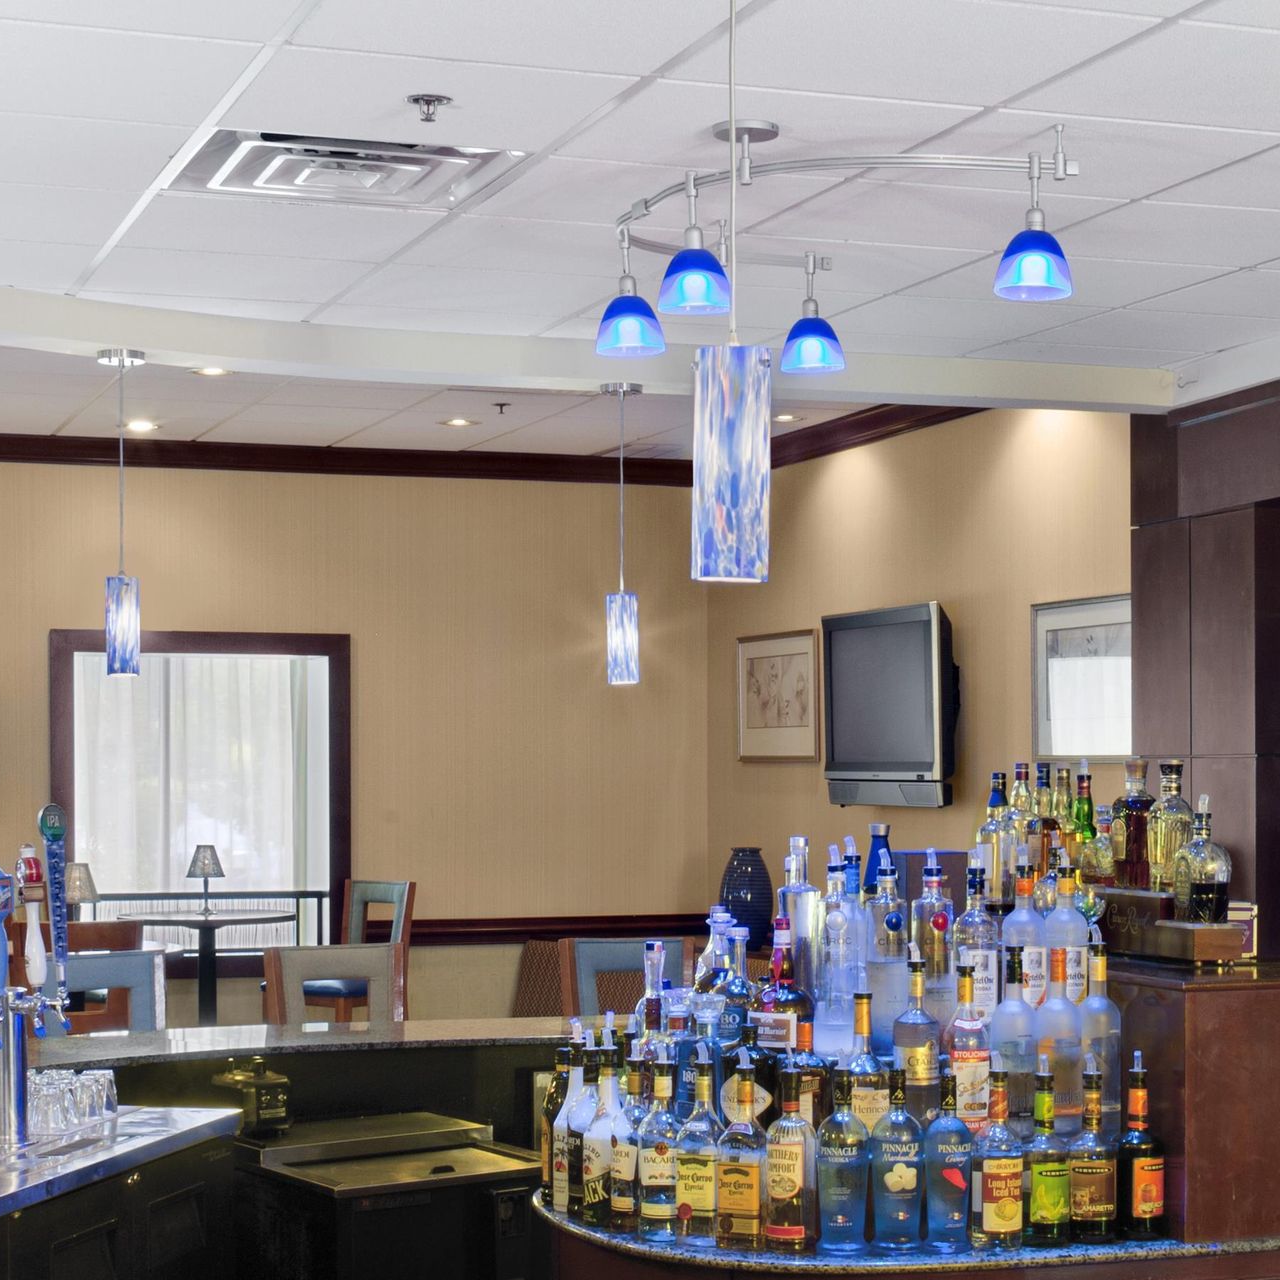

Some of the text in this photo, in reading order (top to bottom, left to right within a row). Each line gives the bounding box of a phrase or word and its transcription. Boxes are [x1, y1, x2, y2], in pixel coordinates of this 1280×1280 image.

[46, 815, 60, 828] IPA
[820, 1146, 858, 1157] PINNACLE
[992, 1187, 1009, 1197] Iced
[1082, 1204, 1114, 1213] AMARETTO
